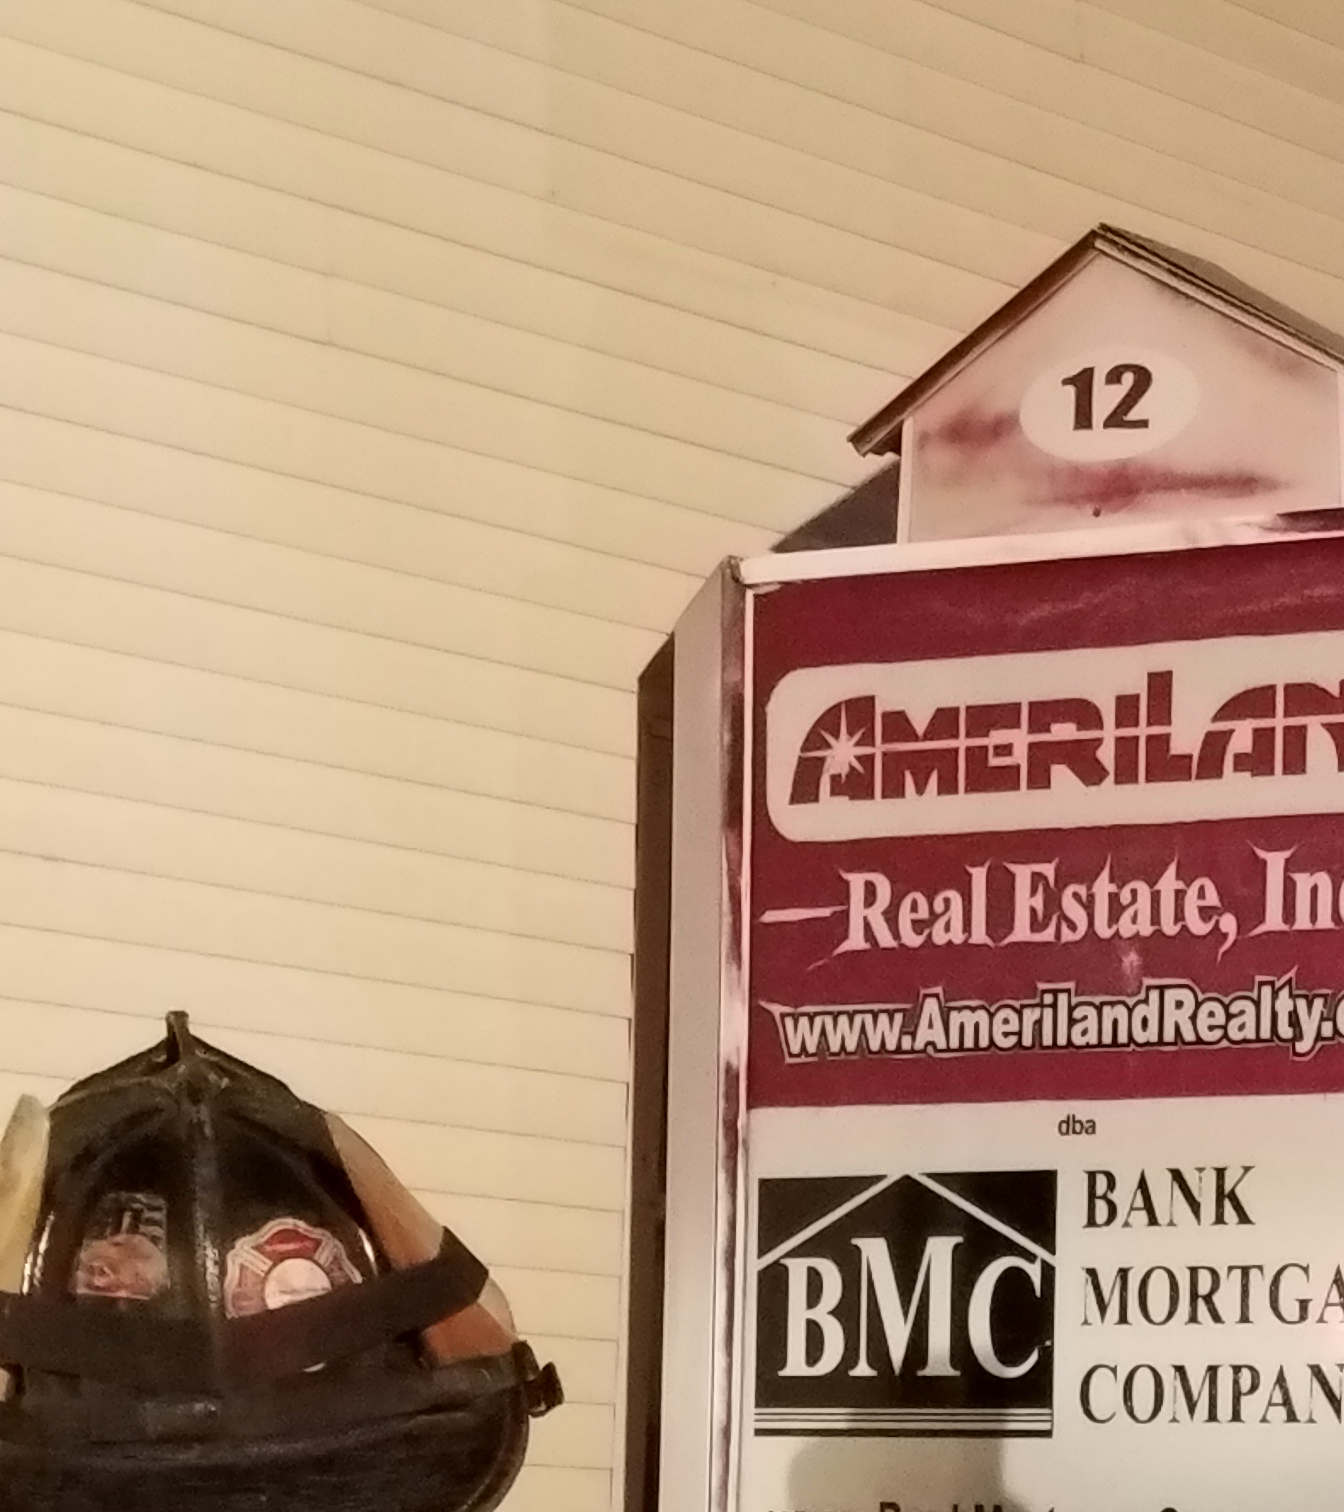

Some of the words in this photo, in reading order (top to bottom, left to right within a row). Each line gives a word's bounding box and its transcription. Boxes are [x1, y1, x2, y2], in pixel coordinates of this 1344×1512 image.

[1060, 362, 1154, 432] 12
[833, 859, 994, 955] Real
[1001, 855, 1239, 962] Estate,
[1057, 1114, 1098, 1138] dba
[1081, 1165, 1257, 1230] BANK
[776, 1235, 1043, 1379] BMC
